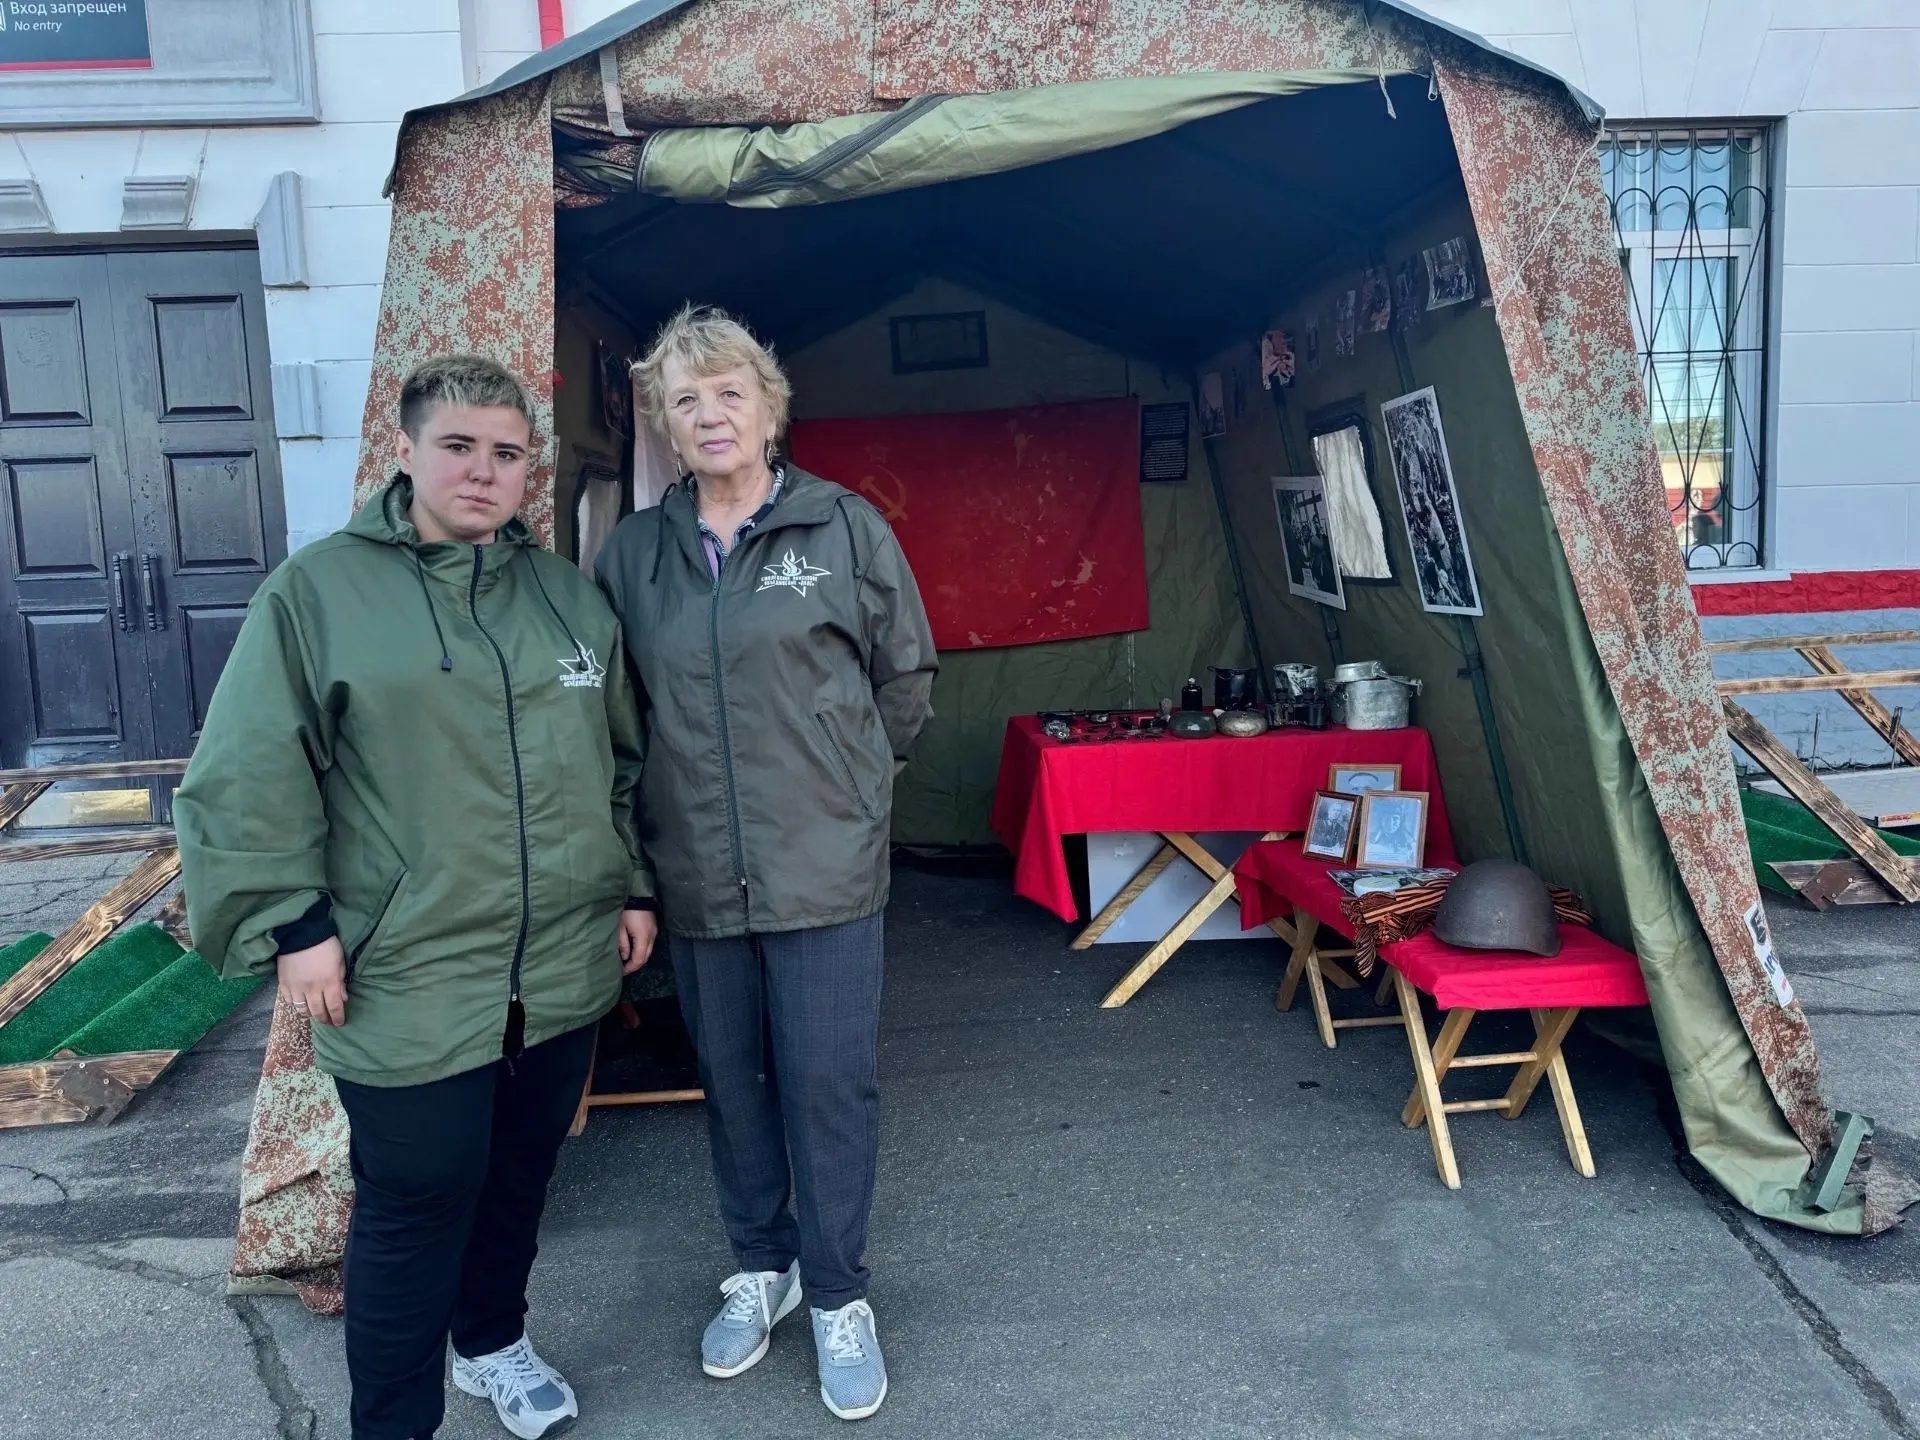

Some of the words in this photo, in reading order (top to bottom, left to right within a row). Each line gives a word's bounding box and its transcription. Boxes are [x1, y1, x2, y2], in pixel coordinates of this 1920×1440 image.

[10, 1, 48, 16] Вход
[50, 2, 127, 16] запрещен
[14, 21, 30, 31] No
[32, 21, 62, 32] entry
